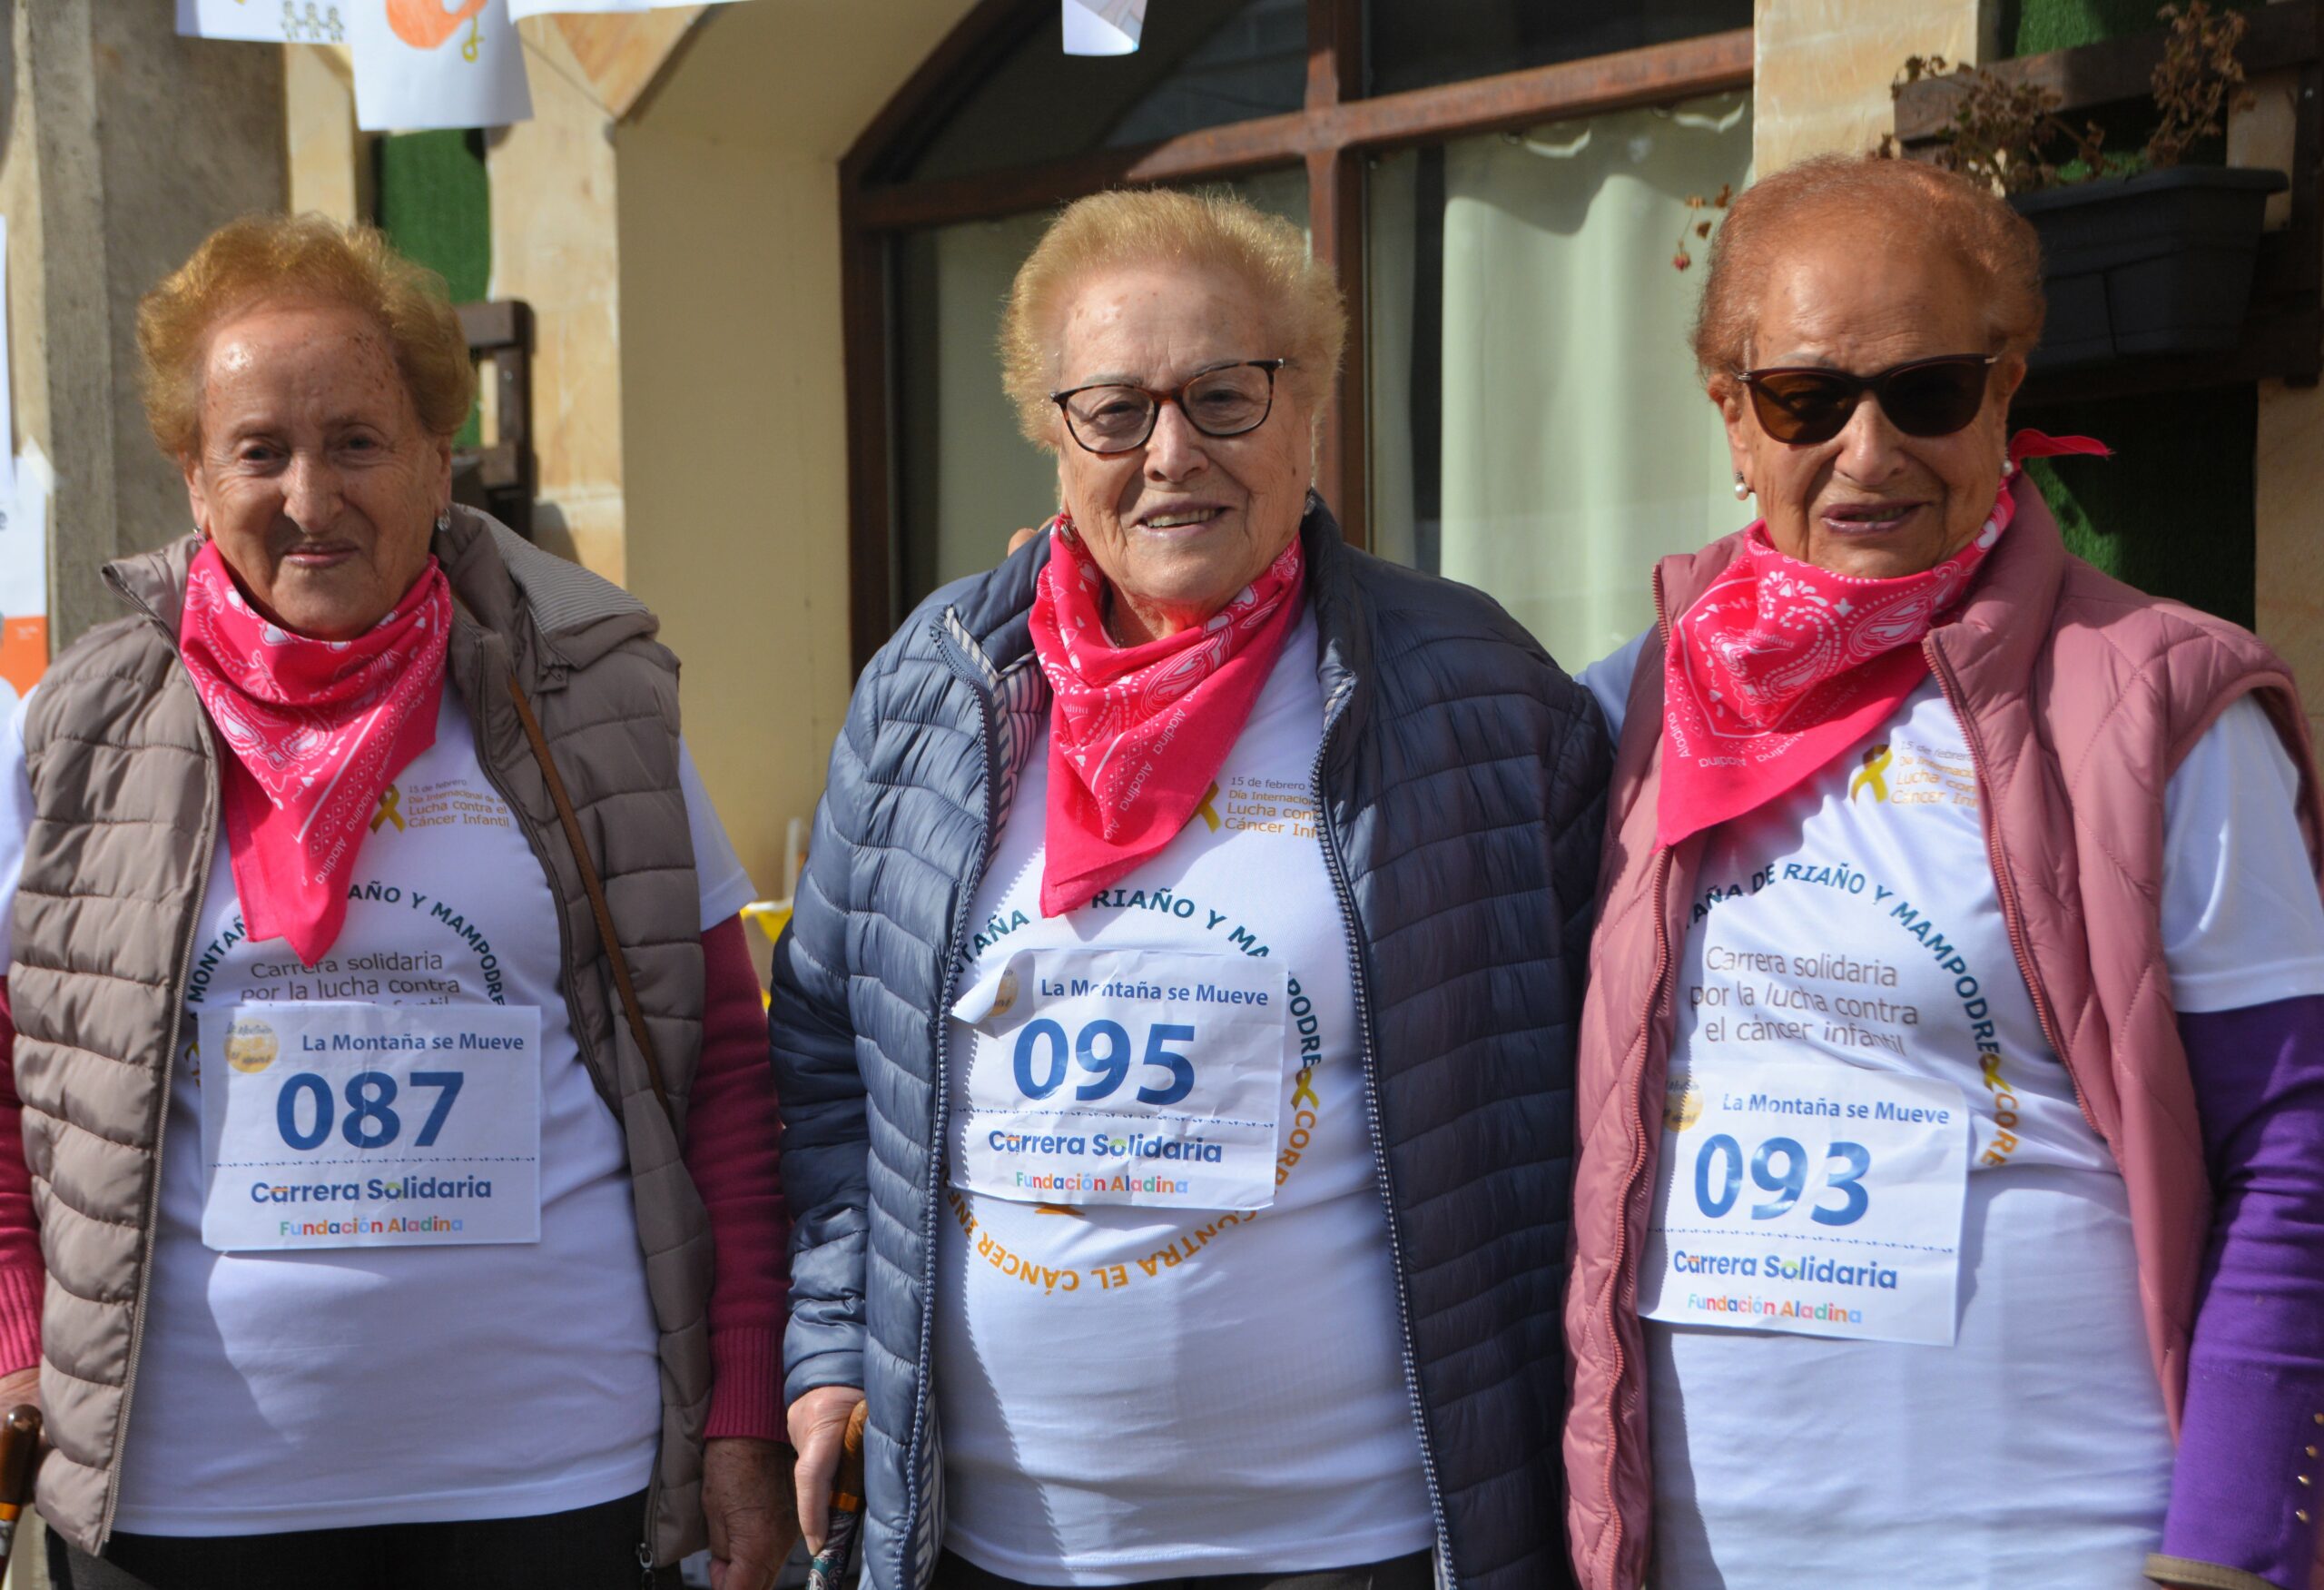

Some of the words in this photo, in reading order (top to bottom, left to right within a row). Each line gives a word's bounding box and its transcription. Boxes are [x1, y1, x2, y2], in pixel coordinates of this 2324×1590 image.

[1152, 707, 1187, 755] Aladina
[1668, 712, 1692, 757] Aladina
[1118, 760, 1153, 811] Aladina
[1229, 789, 1247, 800] Día
[1231, 776, 1245, 785] 15
[1247, 777, 1262, 787] de
[1265, 779, 1305, 790] febrero
[346, 786, 375, 832] Aladina
[409, 802, 448, 815] Lucha
[452, 800, 492, 814] contra
[496, 805, 508, 814] el
[409, 814, 457, 828] Cáncer
[463, 814, 509, 828] Infantil
[1227, 802, 1276, 816] Lucha
[1225, 816, 1285, 833] Cáncer
[315, 835, 347, 884] Aladina
[412, 892, 427, 909] Y
[1091, 888, 1195, 918] RIAÑO
[1206, 909, 1227, 930] Y
[251, 959, 339, 979] Carrera
[348, 951, 443, 972] solidaria
[1706, 946, 1786, 974] Carrera
[1795, 952, 1897, 987] solidaria
[1752, 864, 1775, 893] DE
[1783, 863, 1866, 894] RIAÑO
[1873, 884, 1893, 906] Y
[1890, 901, 2000, 1053] MAMPODRE
[241, 986, 280, 1001] por
[289, 981, 308, 1000] la
[318, 975, 379, 998] lucha
[389, 978, 460, 994] contra
[1041, 979, 1065, 996] La
[1070, 979, 1161, 1000] Montaña
[1167, 985, 1190, 1002] se
[1196, 984, 1268, 1006] Mueve
[1690, 984, 1729, 1011] por
[1738, 981, 1755, 1006] la
[1766, 983, 1829, 1012] lucha
[1836, 997, 1918, 1025] contra
[302, 1034, 326, 1052] La
[332, 1033, 426, 1051] Montaña
[431, 1036, 454, 1050] se
[459, 1032, 524, 1051] Mueve
[1705, 1016, 1726, 1042] el
[1824, 1021, 1906, 1055] infantil
[1012, 1018, 1196, 1105] 095
[276, 1072, 464, 1151] 087
[1722, 1093, 1742, 1111] La
[1748, 1093, 1839, 1118] Montaña
[1846, 1104, 1868, 1119] se
[1876, 1101, 1949, 1124] Mueve
[989, 1130, 1085, 1156] Carrera
[1092, 1132, 1222, 1163] Solidaria
[251, 1181, 360, 1203] Carrera
[367, 1175, 491, 1201] Solidaria
[1016, 1171, 1106, 1191] Fundación
[1110, 1175, 1188, 1193] Aladina
[1695, 1133, 1871, 1227] 093
[280, 1218, 383, 1236] Fundación
[388, 1215, 463, 1233] Aladina
[977, 1231, 1080, 1297] CÁNCER
[1090, 1264, 1129, 1289] EL
[1674, 1250, 1757, 1277] Carrera
[1764, 1254, 1897, 1289] Solidaria
[1688, 1293, 1775, 1315] Fundación
[1781, 1299, 1862, 1324] Aladina
